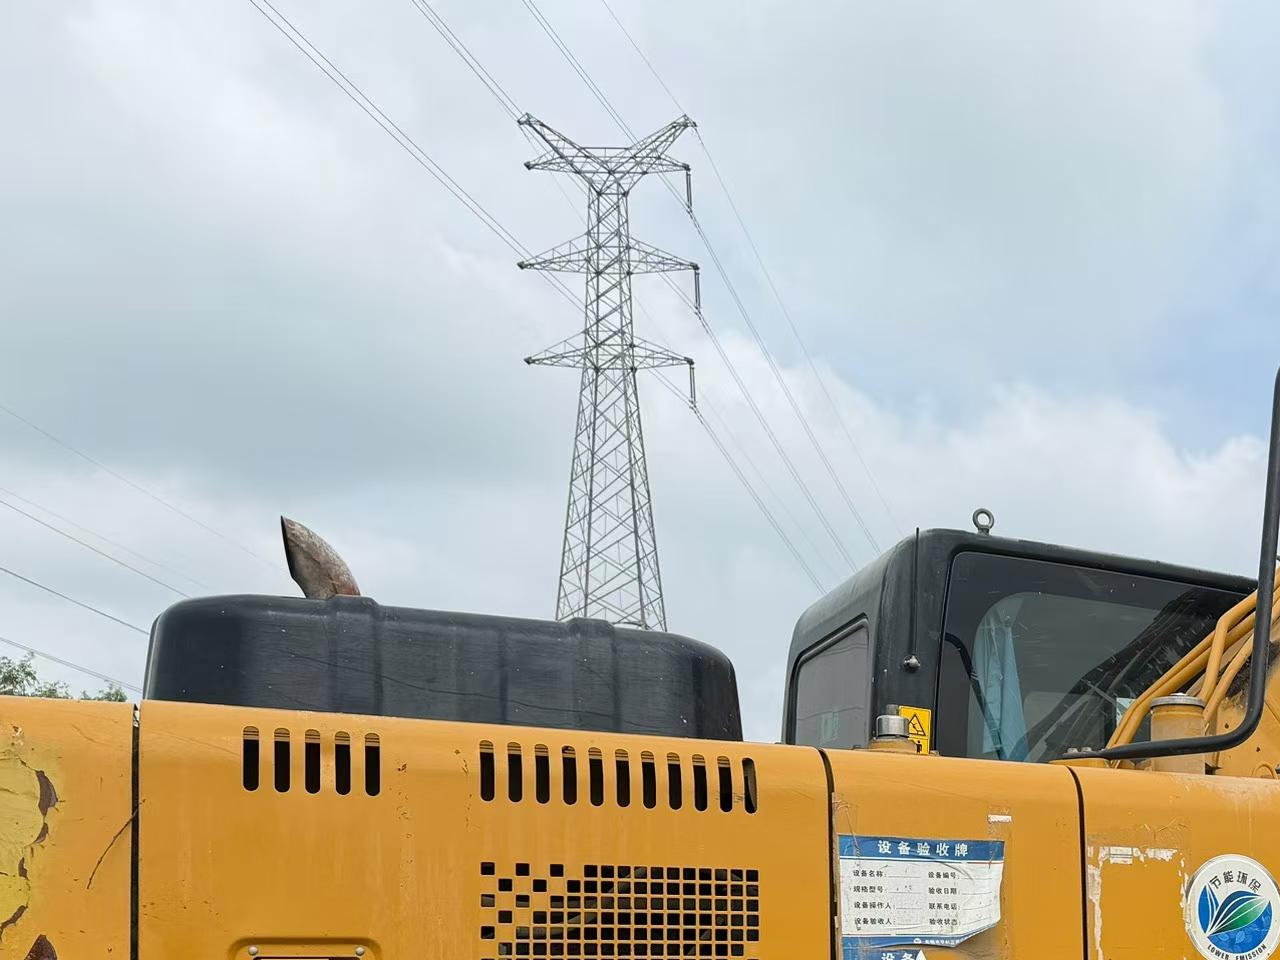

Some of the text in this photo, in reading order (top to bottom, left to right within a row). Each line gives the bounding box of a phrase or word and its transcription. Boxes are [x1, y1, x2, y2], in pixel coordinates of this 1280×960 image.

[877, 840, 969, 857] 设备验收牌
[1209, 870, 1262, 893] 节能环保
[1207, 944, 1230, 960] LOWER
